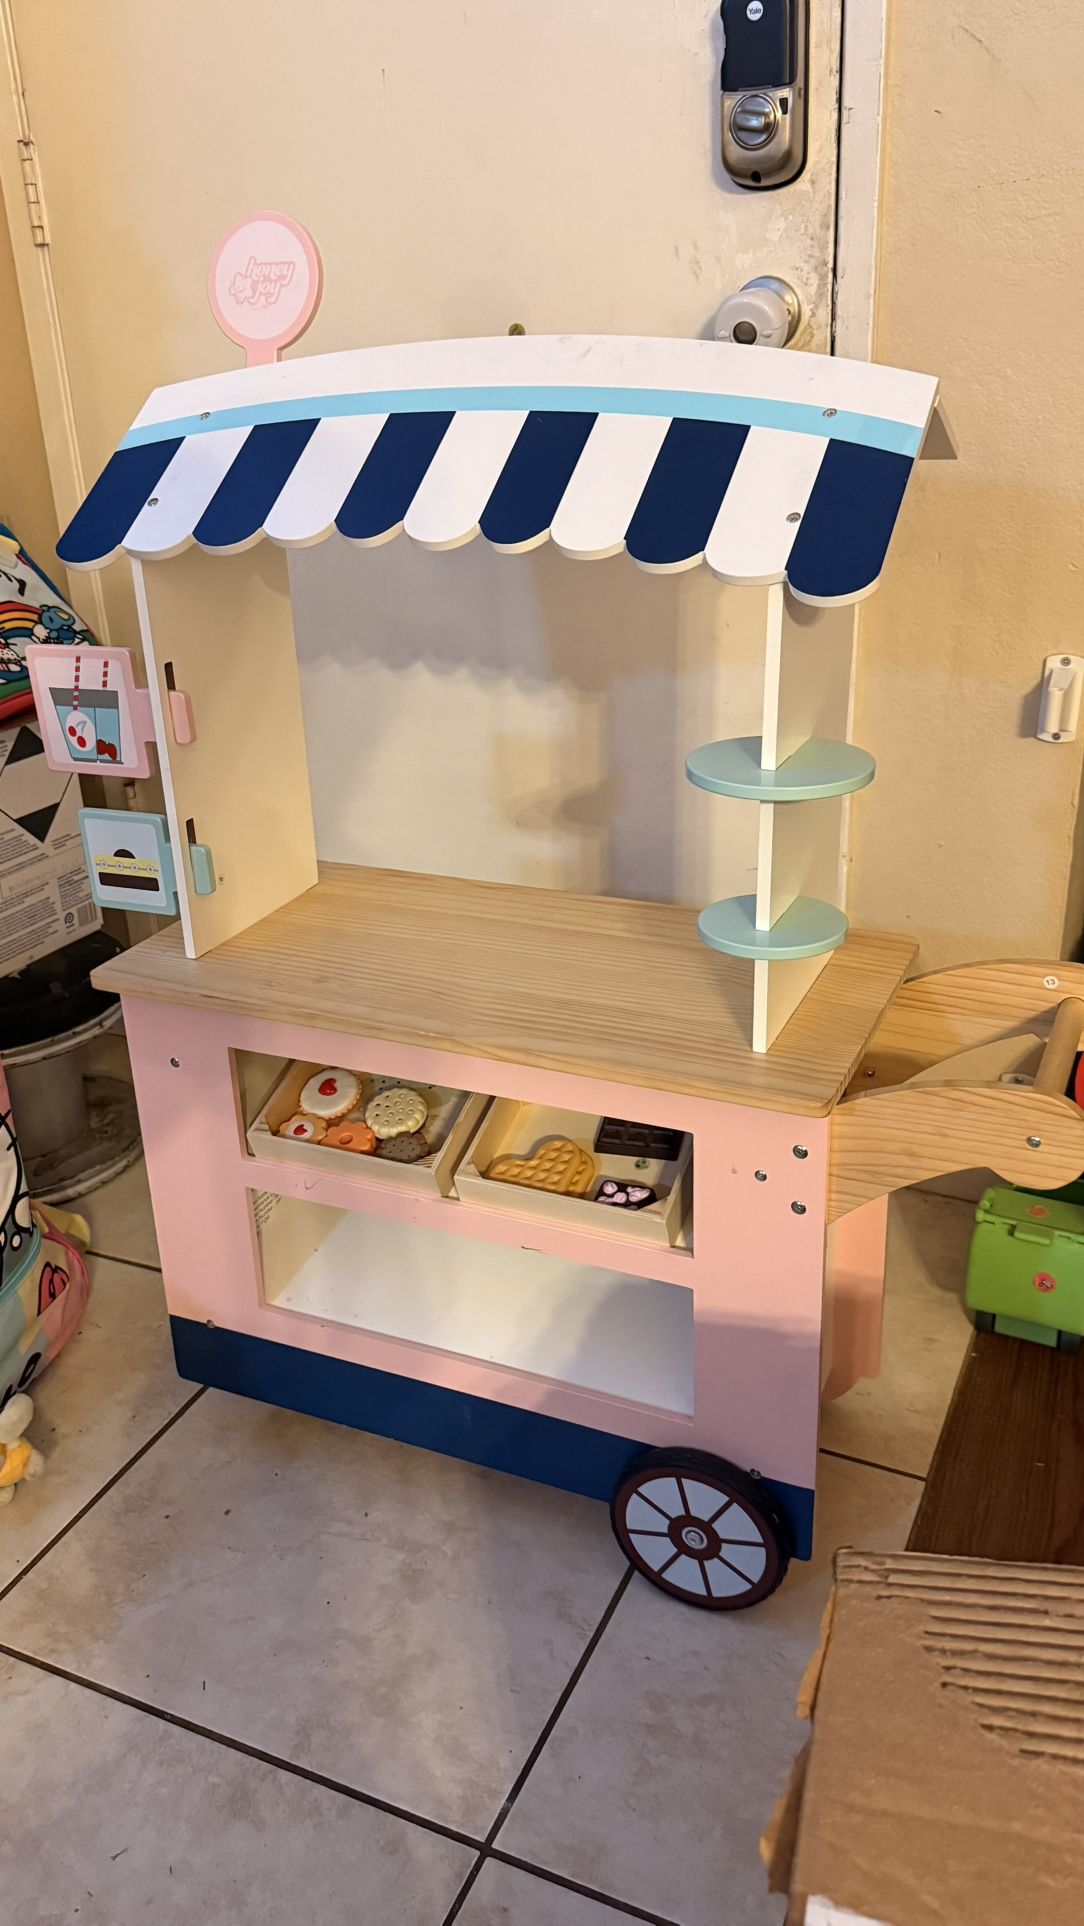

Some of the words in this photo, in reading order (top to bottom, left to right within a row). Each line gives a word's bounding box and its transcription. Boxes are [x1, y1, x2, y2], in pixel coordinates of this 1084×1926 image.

[748, 7, 762, 15] Yale
[245, 256, 296, 288] honey
[247, 278, 281, 305] joy
